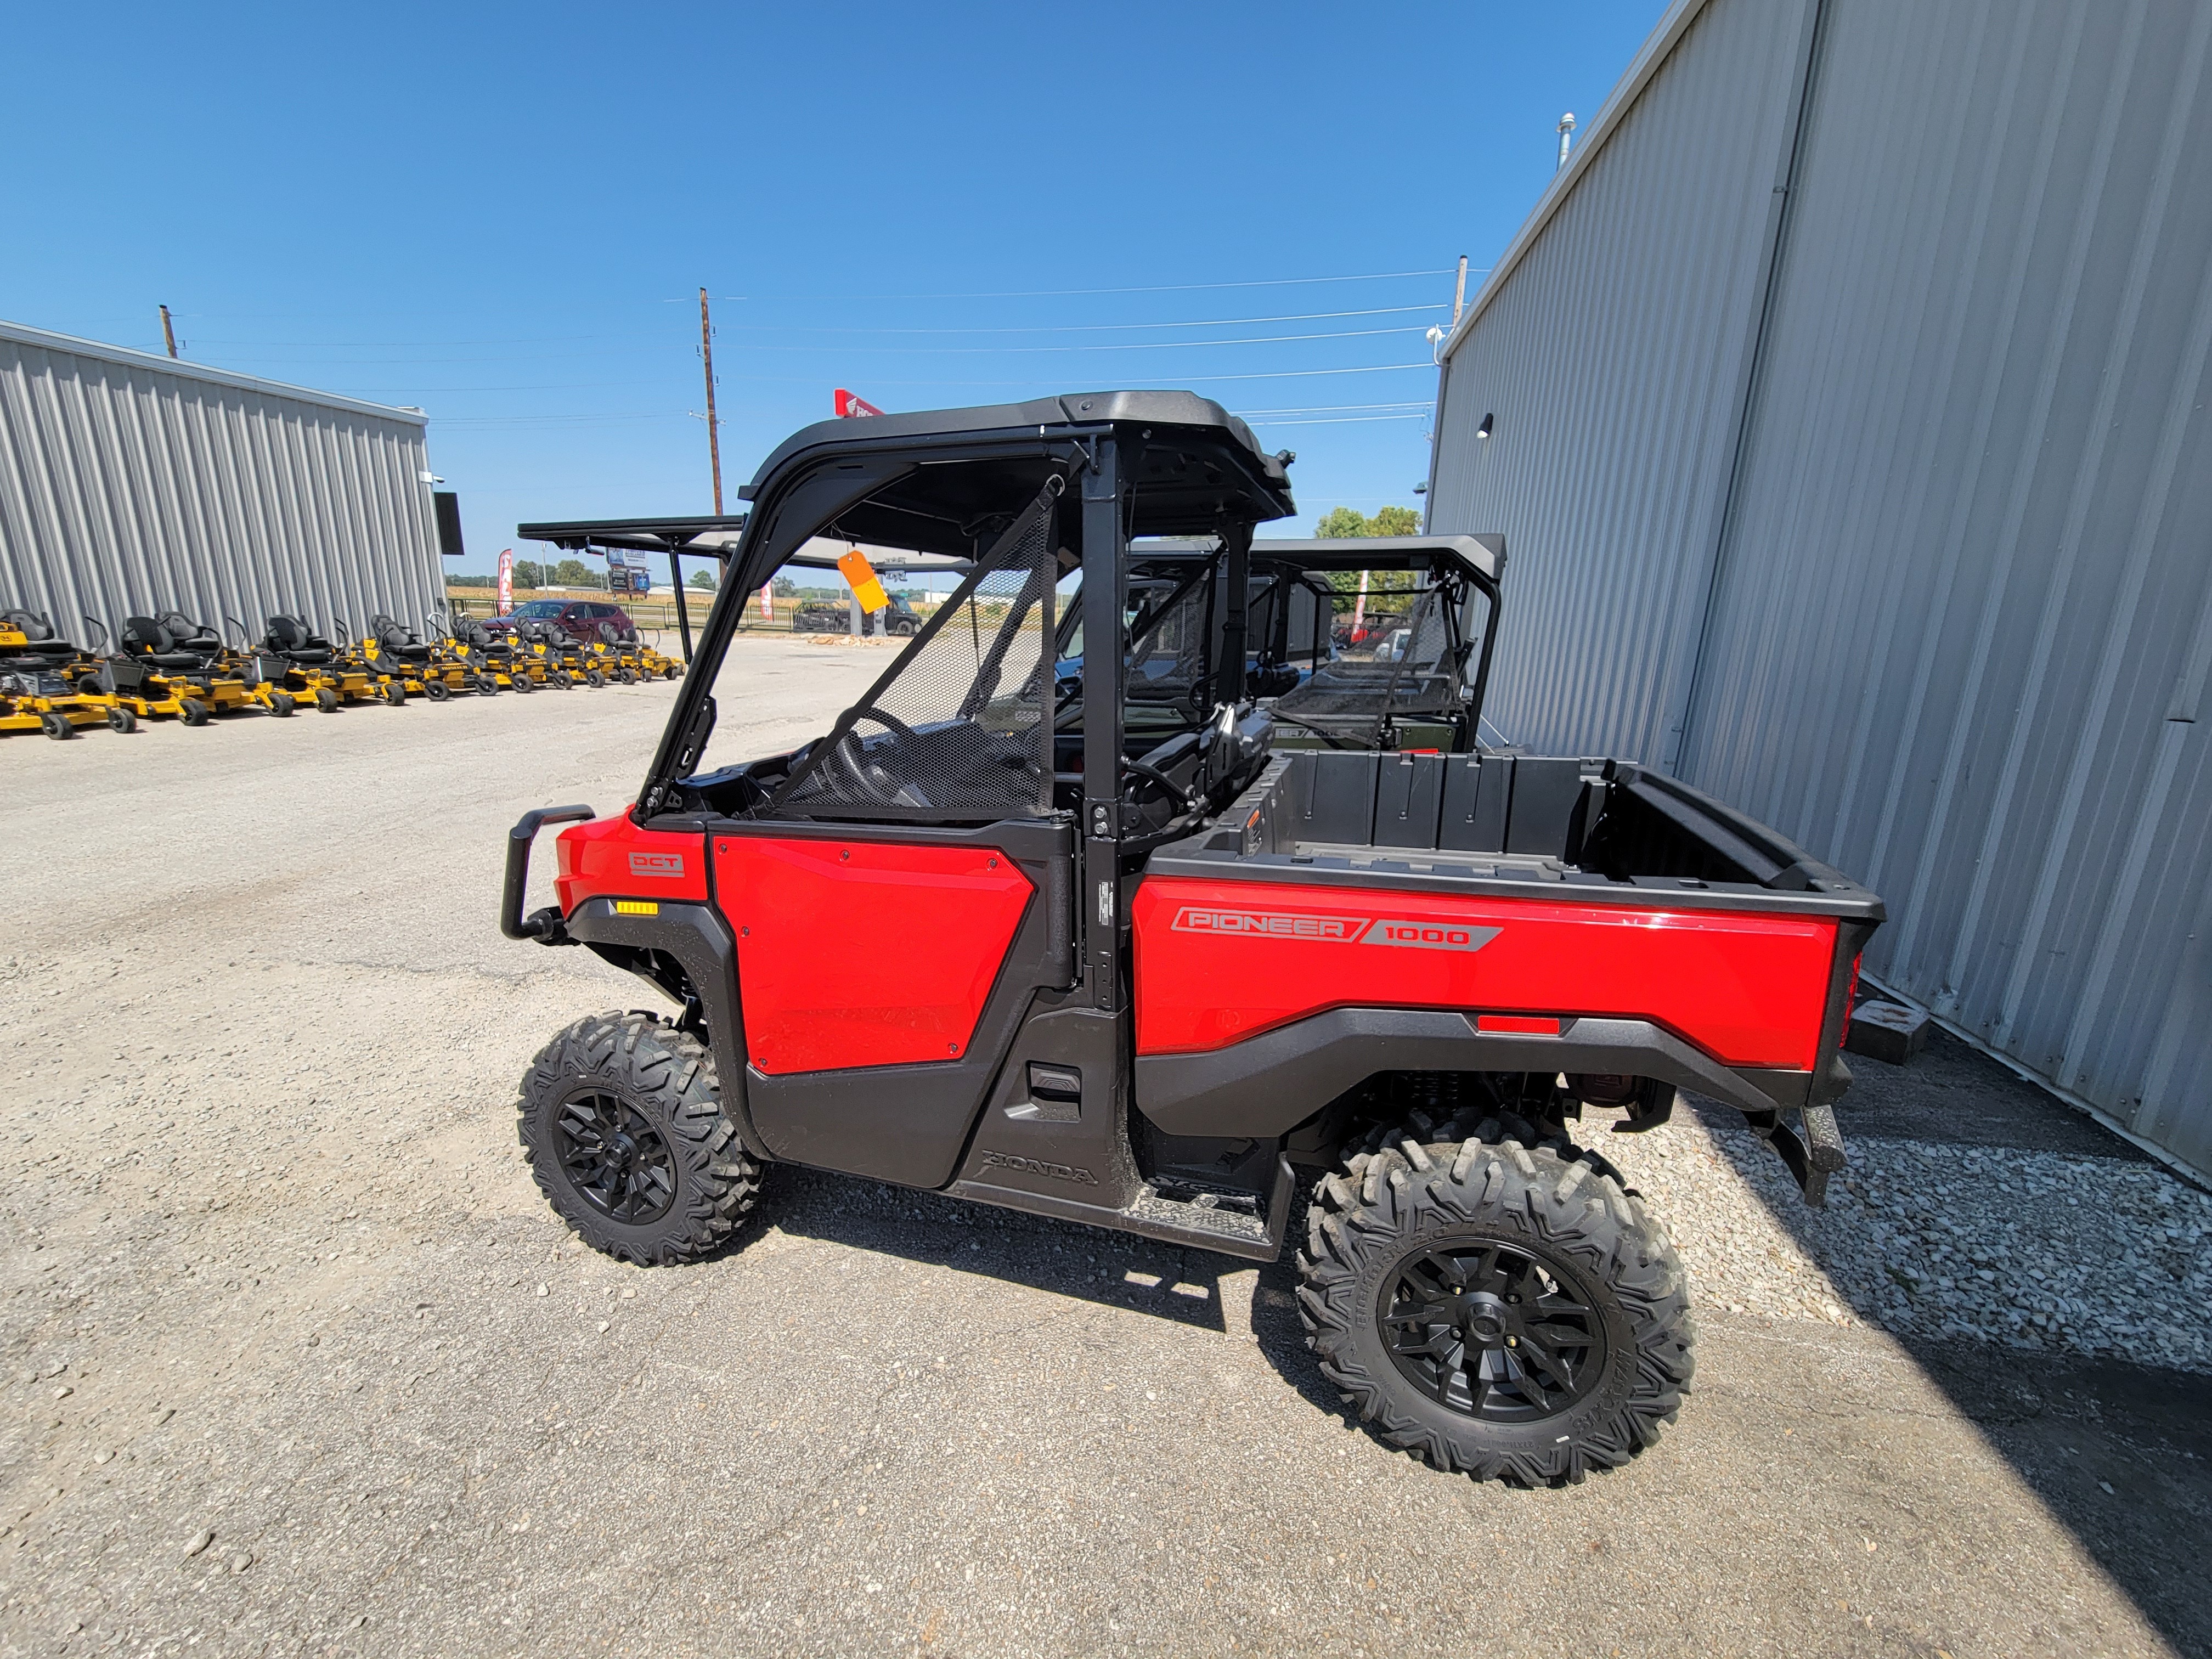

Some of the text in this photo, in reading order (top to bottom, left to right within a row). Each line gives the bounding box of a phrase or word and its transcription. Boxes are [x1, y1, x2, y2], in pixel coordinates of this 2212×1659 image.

[501, 554, 511, 605] SALE
[633, 856, 679, 867] DCT
[1188, 913, 1470, 945] PIONEER 1000
[981, 1149, 1099, 1186] HONDA
[1356, 1242, 1406, 1326] BIGHORN
[1572, 1347, 1633, 1429] MAXXIS
